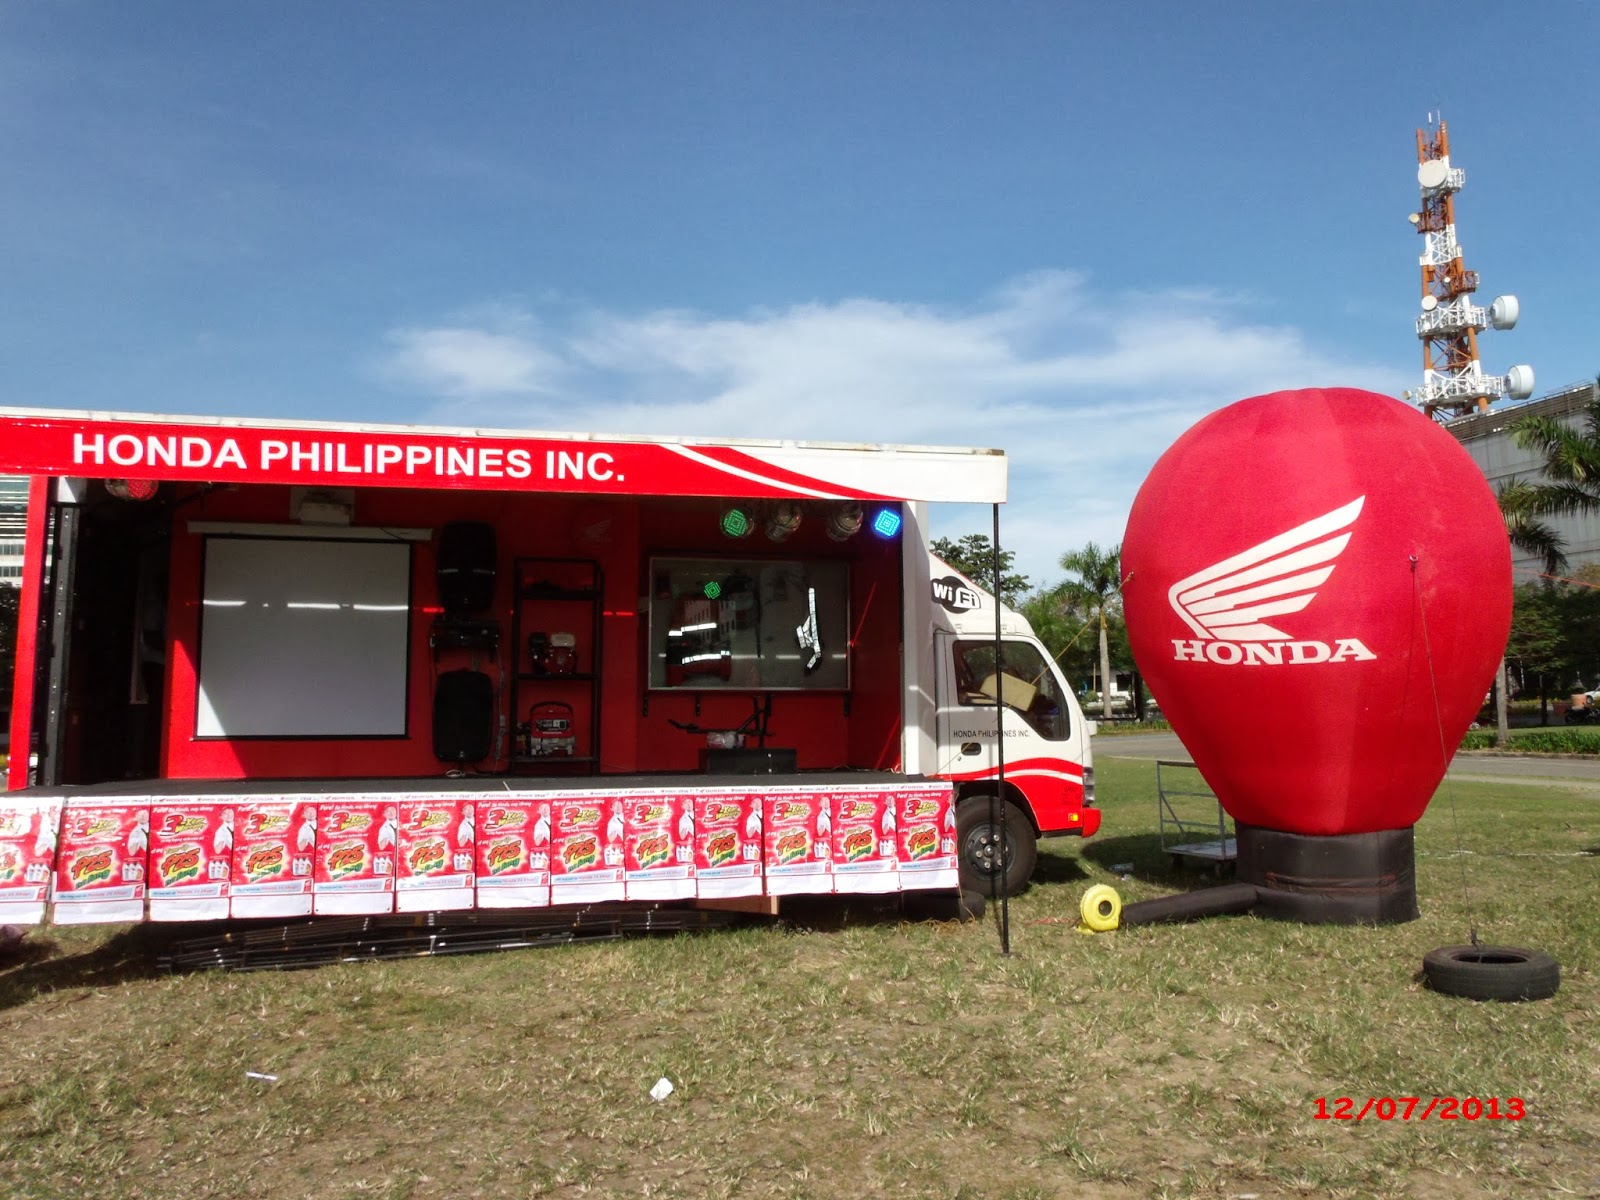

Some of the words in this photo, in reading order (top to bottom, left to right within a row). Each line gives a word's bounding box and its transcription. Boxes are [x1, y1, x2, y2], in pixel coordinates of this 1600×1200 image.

[73, 433, 247, 469] HONDA
[260, 440, 532, 479] PHILIPPINES
[546, 450, 625, 482] INC.
[1171, 639, 1377, 666] HONDA
[953, 729, 977, 739] HONDA
[1018, 729, 1031, 739] INC.
